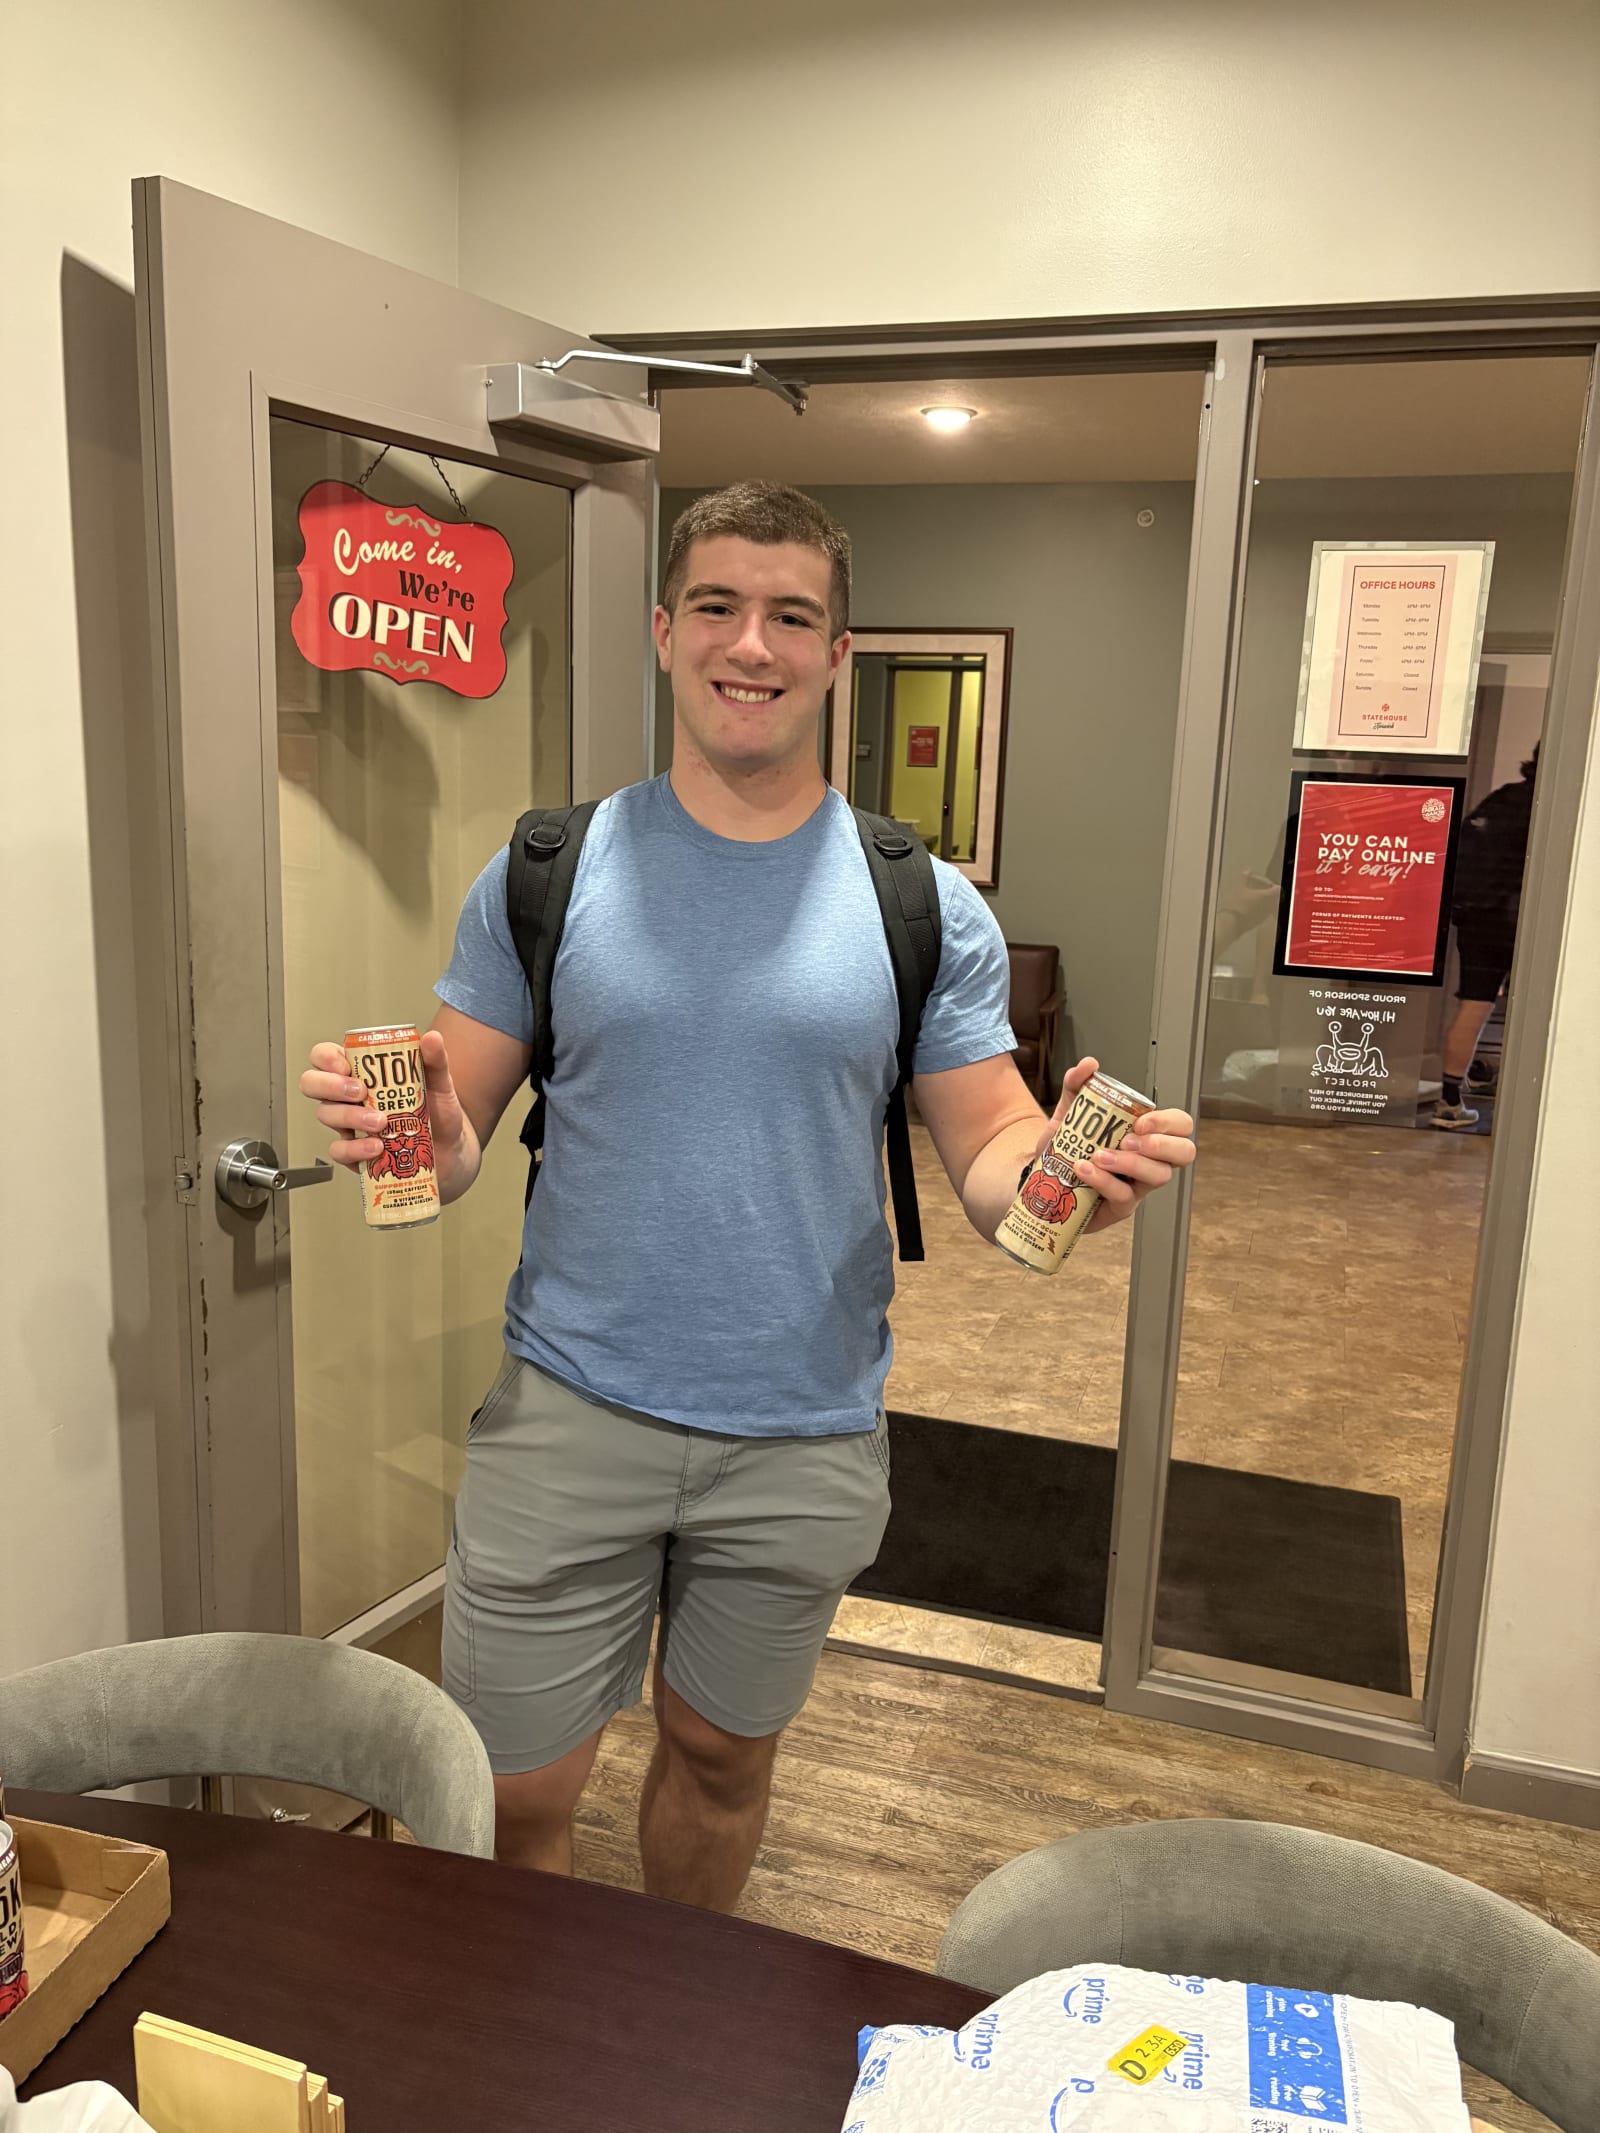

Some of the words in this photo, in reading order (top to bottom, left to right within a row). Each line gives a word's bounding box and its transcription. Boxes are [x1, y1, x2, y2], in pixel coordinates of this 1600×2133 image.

[333, 528, 416, 576] Come
[426, 541, 463, 574] in,
[398, 570, 475, 612] We're
[1360, 580, 1397, 590] OFFICE
[1399, 580, 1436, 590] HOURS
[328, 592, 475, 664] OPEN
[1362, 714, 1408, 722] STATEHOUSE
[1320, 833, 1359, 847] YOU
[1365, 835, 1408, 849] CAN
[1318, 847, 1354, 861] PAY
[1361, 849, 1436, 865] ONLINE
[1358, 861, 1416, 885] easy!
[376, 1086, 415, 1100] COLD
[377, 1097, 416, 1112] BREW
[1056, 1138, 1092, 1160] BREW
[1062, 1129, 1096, 1154] COLD
[1082, 1978, 1110, 2024] prime
[970, 2013, 1002, 2070] prime
[1164, 2040, 1185, 2056] 650
[1118, 2060, 1147, 2080] D
[1178, 2030, 1210, 2090] prime
